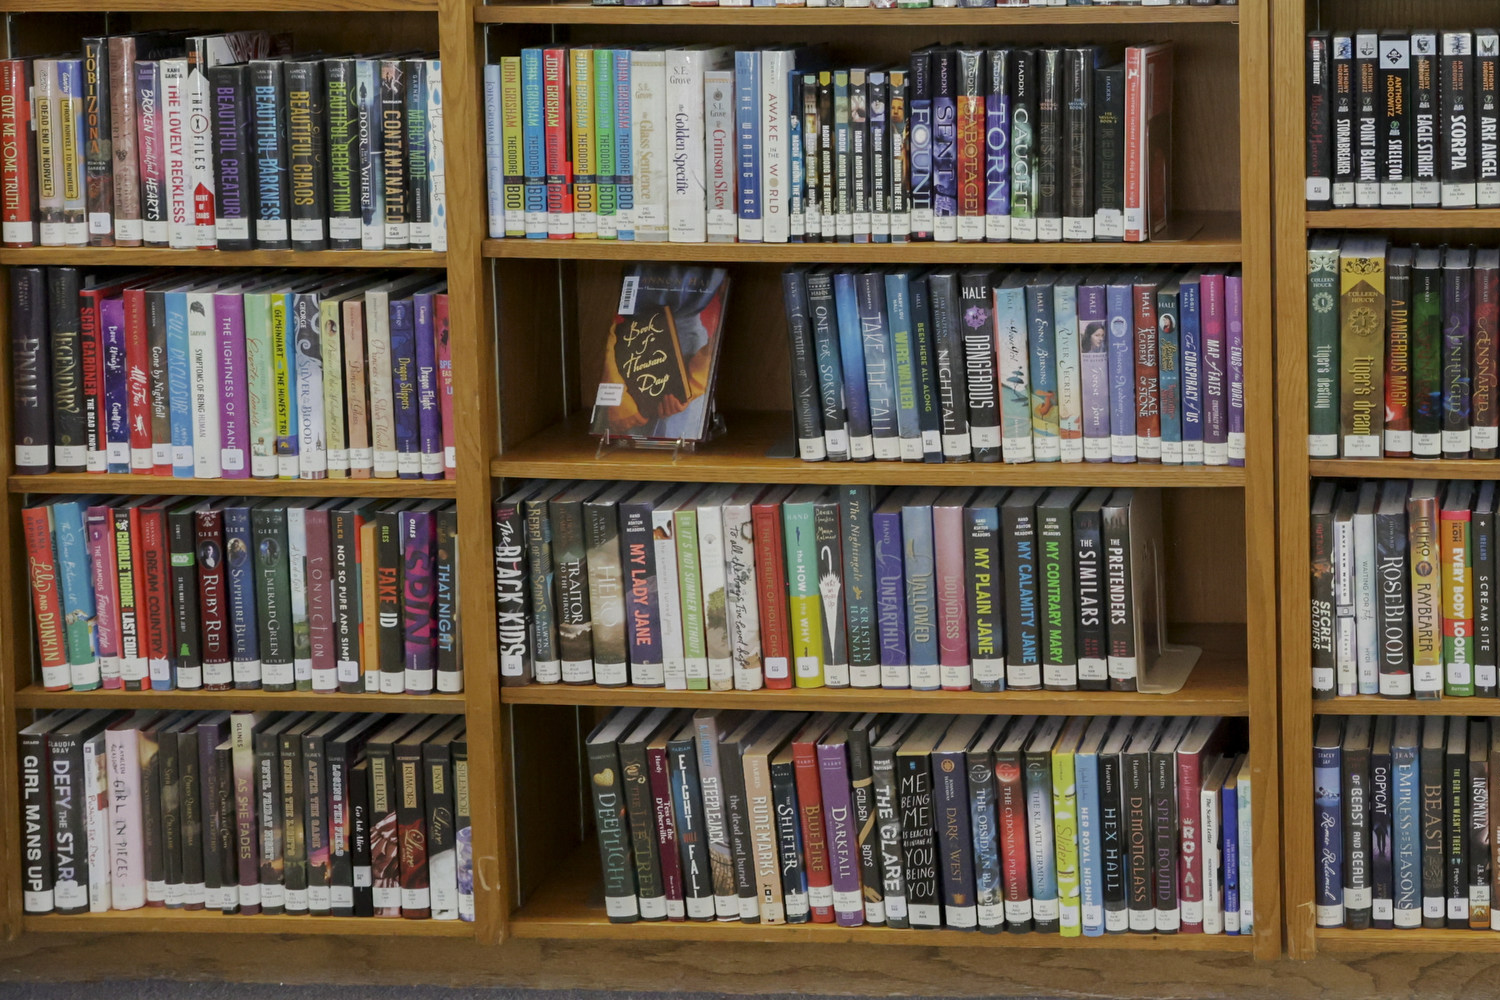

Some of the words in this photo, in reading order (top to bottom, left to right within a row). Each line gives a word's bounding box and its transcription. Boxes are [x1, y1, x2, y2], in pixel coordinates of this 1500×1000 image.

[546, 54, 557, 81] JOHN
[168, 85, 181, 106] THE
[169, 112, 182, 154] LOVELY
[675, 113, 689, 150] Golden
[769, 93, 778, 142] AWAKE
[1361, 117, 1375, 146] POINT
[986, 101, 1006, 201] TORN
[1014, 108, 1028, 213] CAUGHT
[1451, 115, 1466, 170] SCORPIA
[675, 153, 689, 195] Specific
[1361, 150, 1375, 180] BLANK
[171, 160, 185, 223] RECKLESS
[963, 287, 986, 299] HALE
[223, 317, 231, 335] THE
[624, 314, 663, 341] Book
[223, 341, 233, 397] LIGHTNESS
[965, 335, 993, 409] DANGEROUS
[225, 402, 234, 416] OF
[629, 545, 645, 565] MY
[975, 549, 989, 569] MY
[1080, 539, 1092, 547] THE
[379, 568, 396, 603] FAKE
[496, 545, 523, 603] BLACK
[631, 571, 648, 605] LADY
[1079, 551, 1098, 626] SIMILARS
[203, 574, 218, 616] RUBY
[406, 551, 426, 645] SPIN
[976, 574, 991, 614] PLAIN
[1379, 556, 1403, 665] ROSEBLOOD
[206, 620, 221, 652] RED
[380, 612, 397, 627] ID
[499, 612, 525, 656] KIDS
[634, 610, 650, 645] JANE
[978, 619, 993, 655] JANE
[24, 756, 40, 799] GIRL
[902, 773, 927, 794] ME
[1375, 767, 1386, 815] COPYCAT
[703, 777, 724, 844] STEEPLEJACK
[876, 785, 892, 819] THE
[901, 795, 929, 807] BEING
[26, 806, 41, 859] MANS
[1104, 808, 1117, 841] HEX
[882, 826, 900, 891] GLARE
[905, 849, 932, 866] YOU
[1106, 850, 1119, 892] HALL
[1182, 828, 1194, 898] ROYAL
[28, 866, 42, 891] UP
